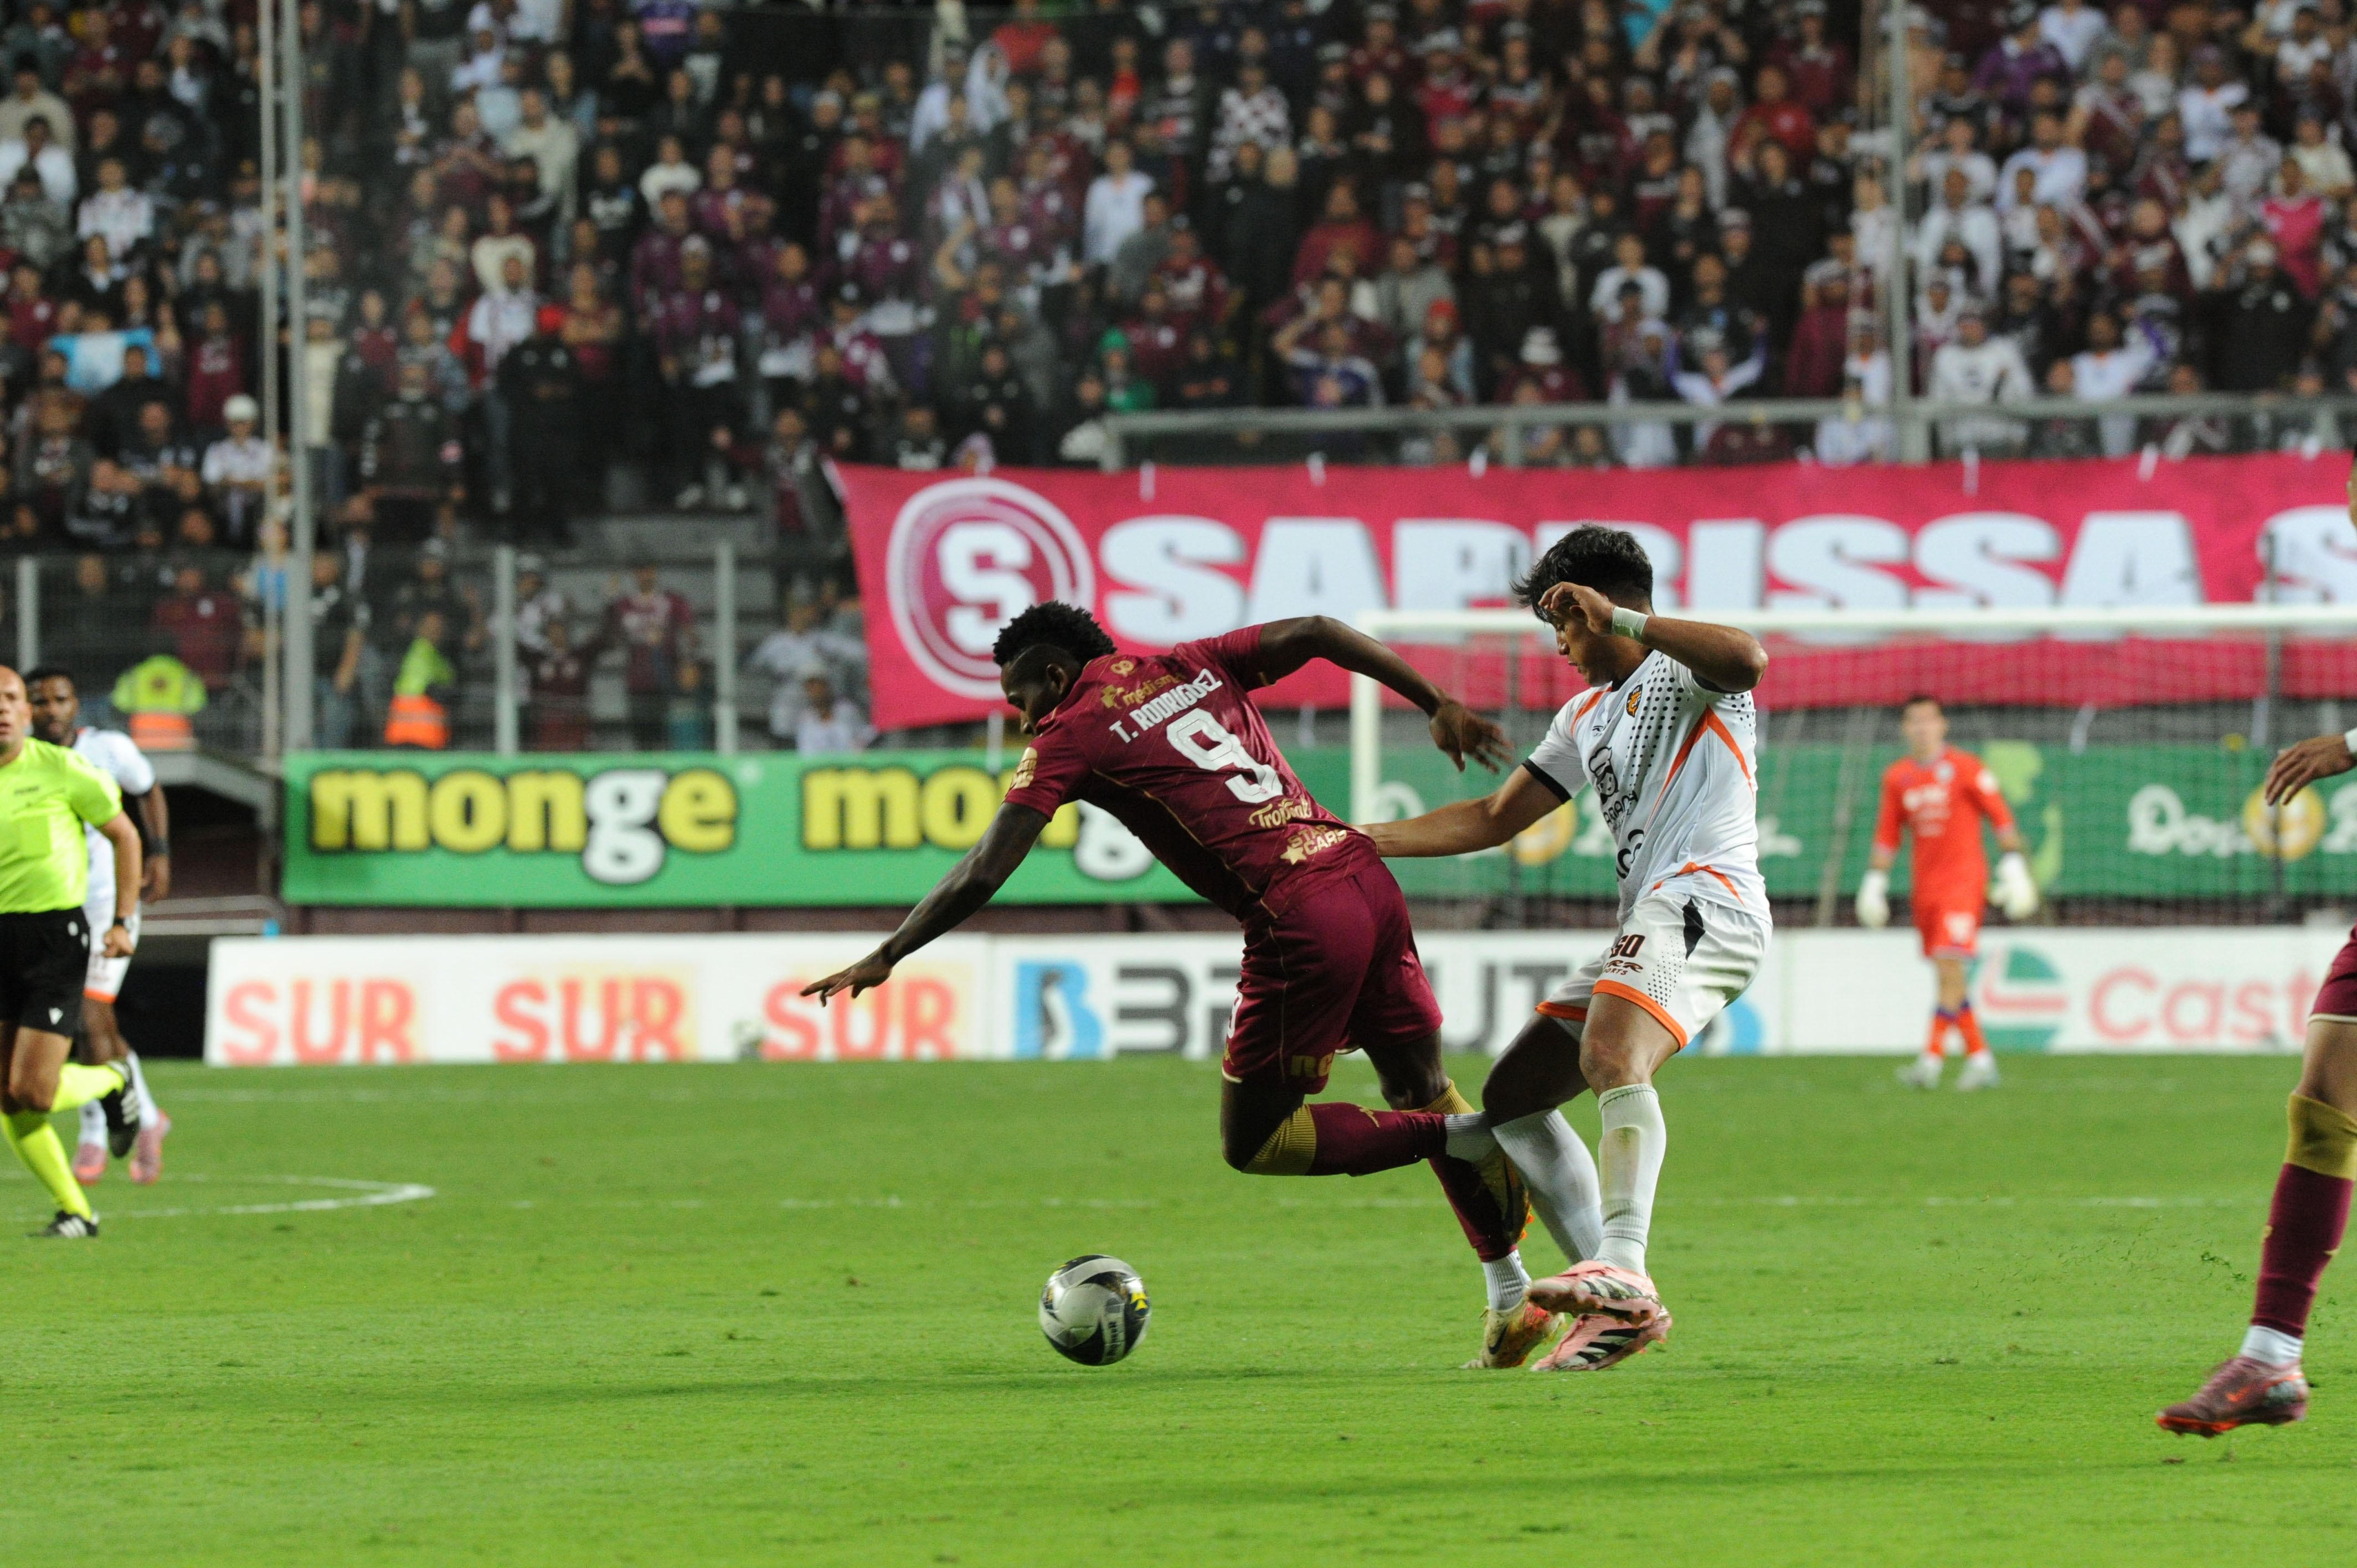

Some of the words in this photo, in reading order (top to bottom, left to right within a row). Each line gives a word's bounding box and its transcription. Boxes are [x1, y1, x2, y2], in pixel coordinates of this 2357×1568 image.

[1109, 720, 1139, 744] T.
[1166, 707, 1284, 803] 9
[310, 768, 738, 885] monge
[1304, 829, 1347, 856] CARS
[223, 978, 416, 1064] SUR
[493, 976, 686, 1063] SUR
[762, 974, 958, 1061] SUR
[2087, 966, 2320, 1043] Cast
